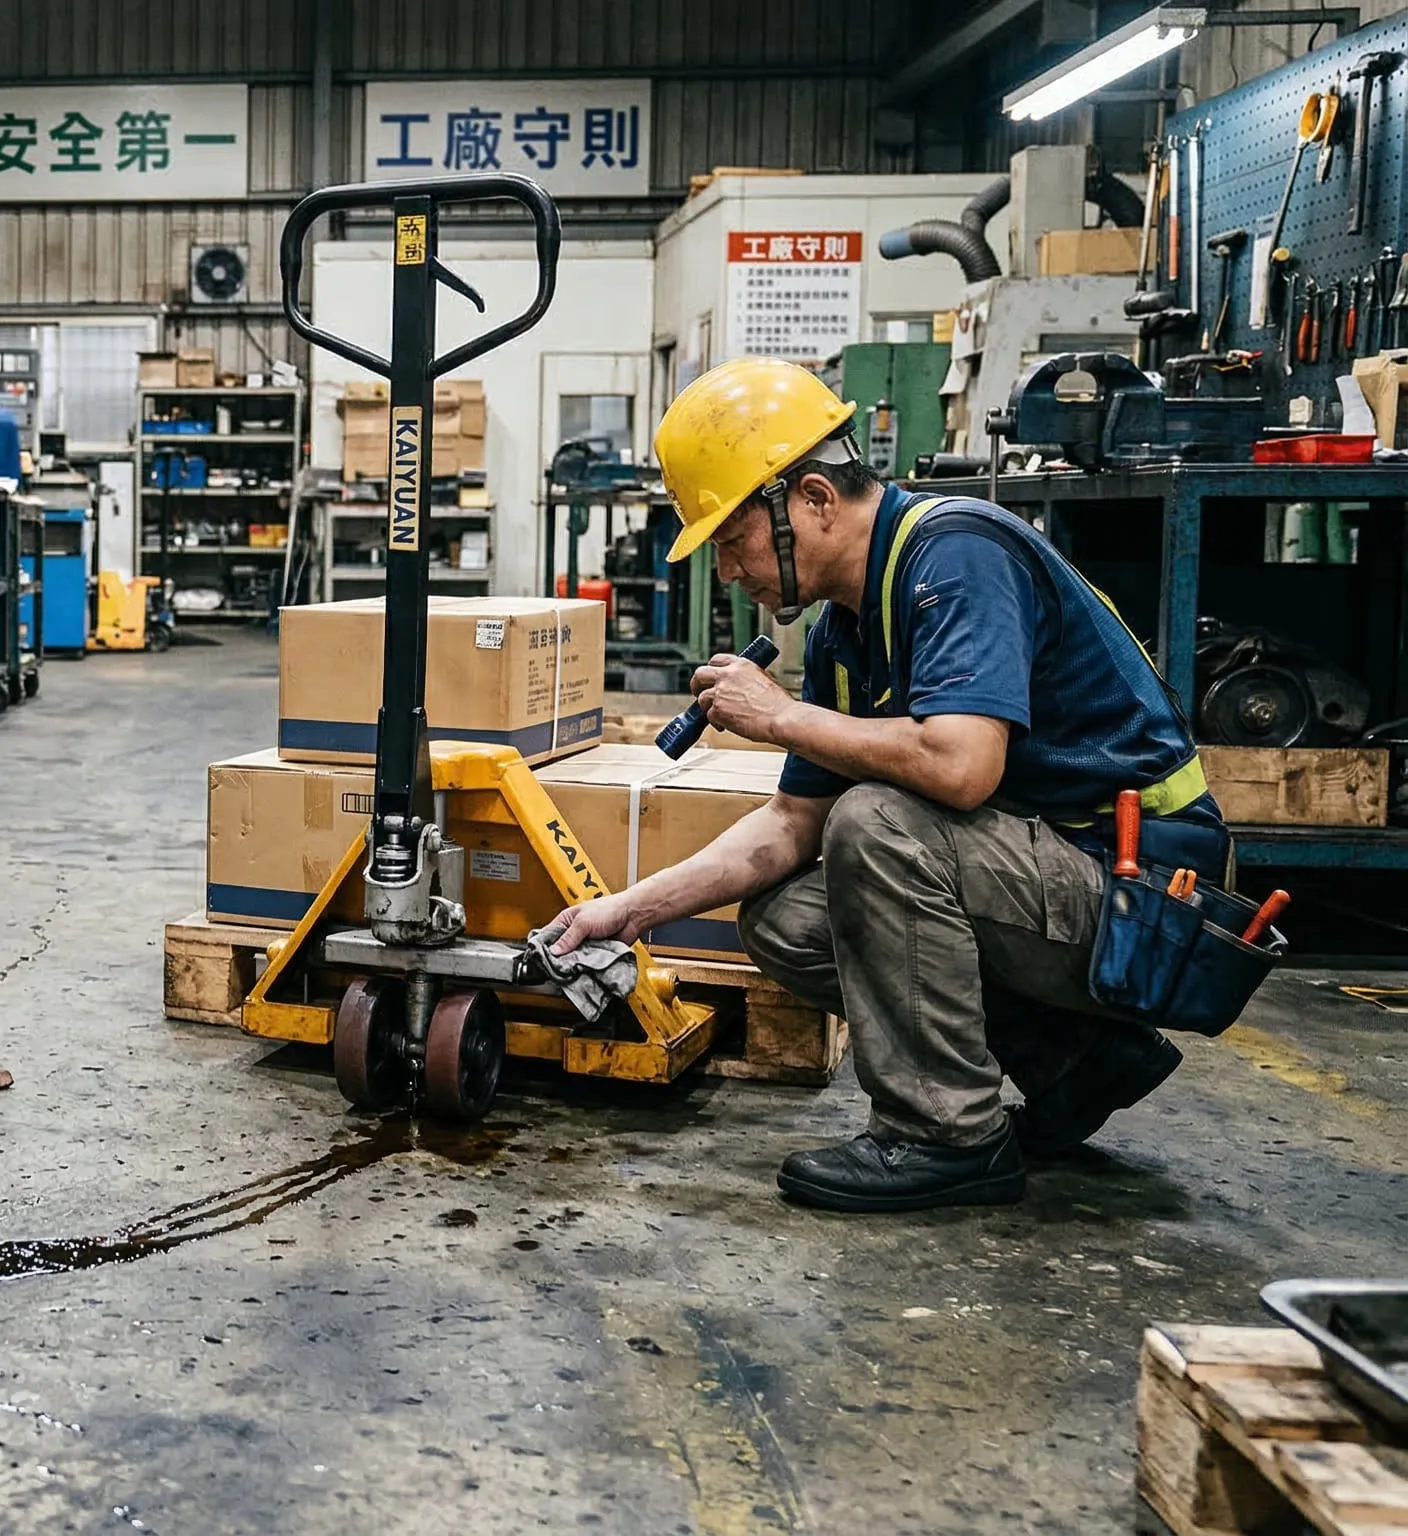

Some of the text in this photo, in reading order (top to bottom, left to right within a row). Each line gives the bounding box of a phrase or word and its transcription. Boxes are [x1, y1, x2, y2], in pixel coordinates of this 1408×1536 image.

[377, 106, 640, 170] 工廠守則
[393, 419, 419, 544] KAIYUAN
[545, 819, 604, 899] KAIY
